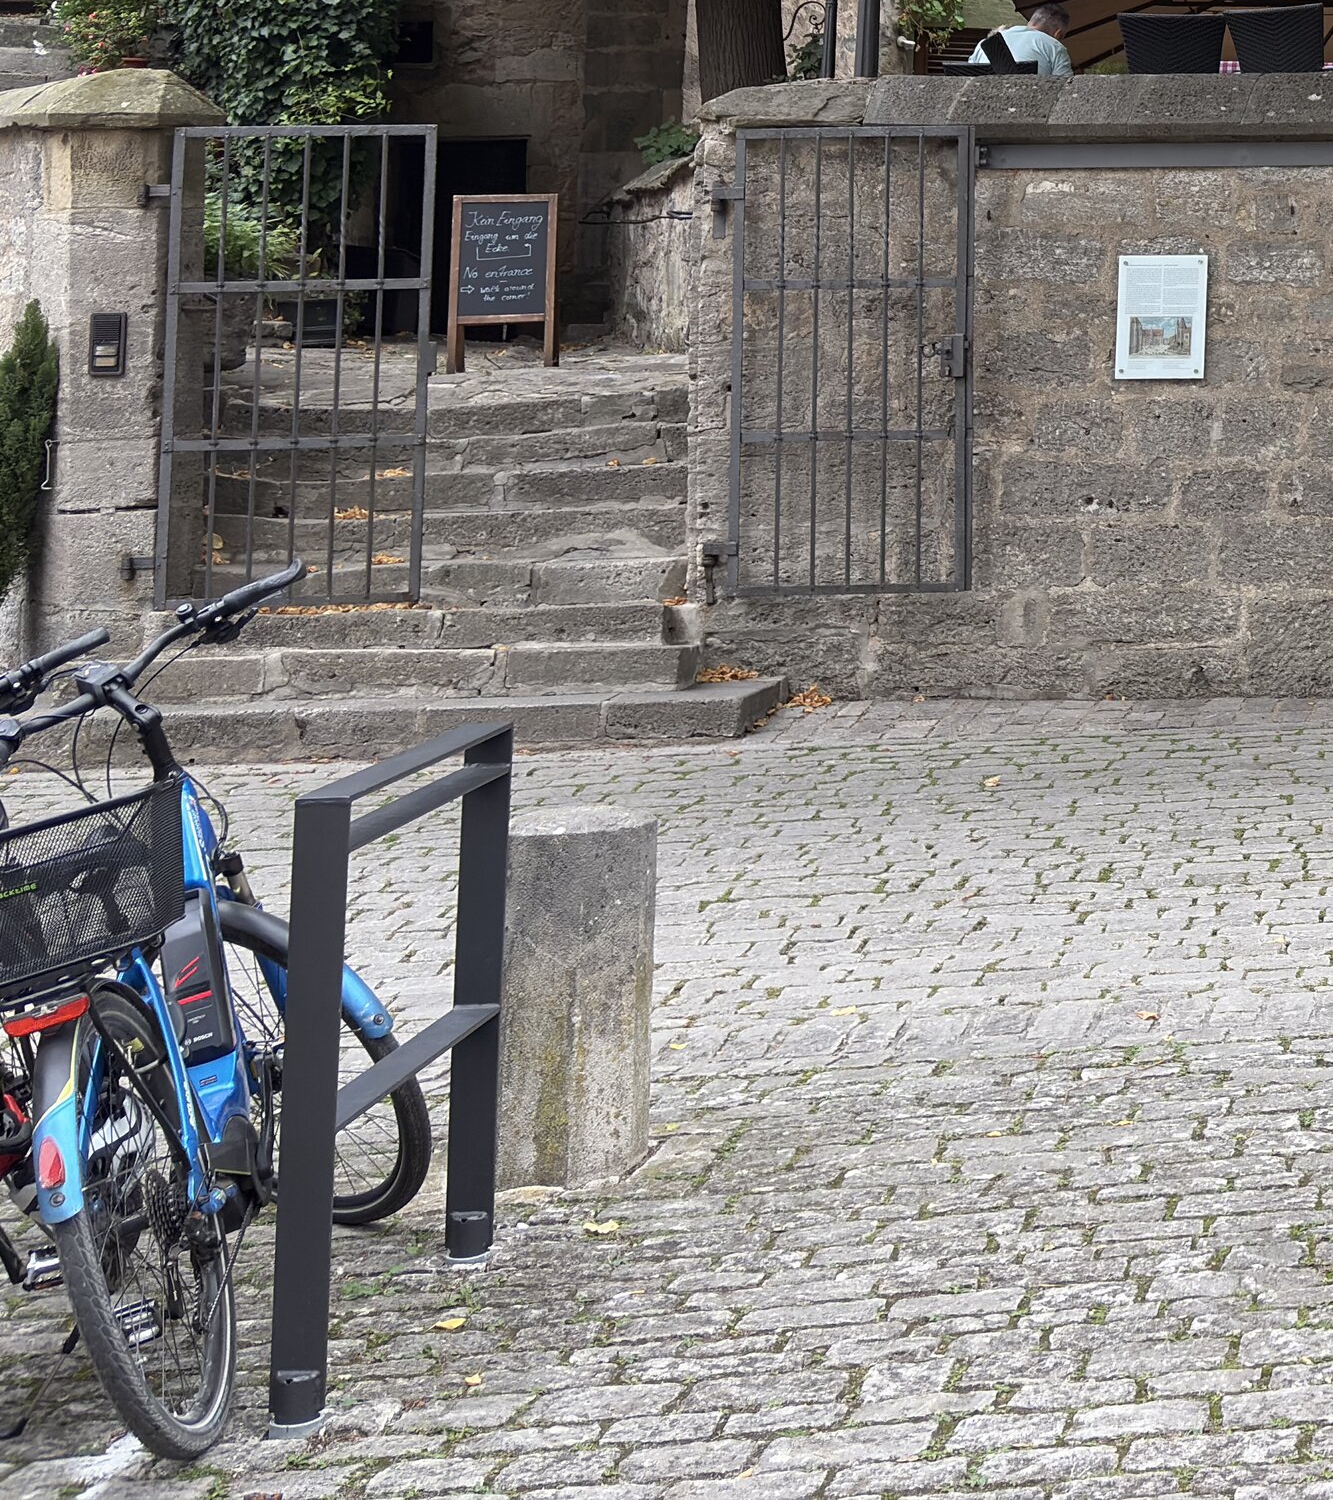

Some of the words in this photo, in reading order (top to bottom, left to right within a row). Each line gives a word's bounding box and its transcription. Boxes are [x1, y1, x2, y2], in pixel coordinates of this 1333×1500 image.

[465, 211, 495, 228] Kein
[496, 210, 544, 231] Eingang
[464, 230, 499, 245] Eingang
[524, 231, 538, 240] die
[463, 266, 479, 280] No
[485, 265, 534, 278] entrance
[504, 283, 535, 292] around
[483, 294, 496, 302] the
